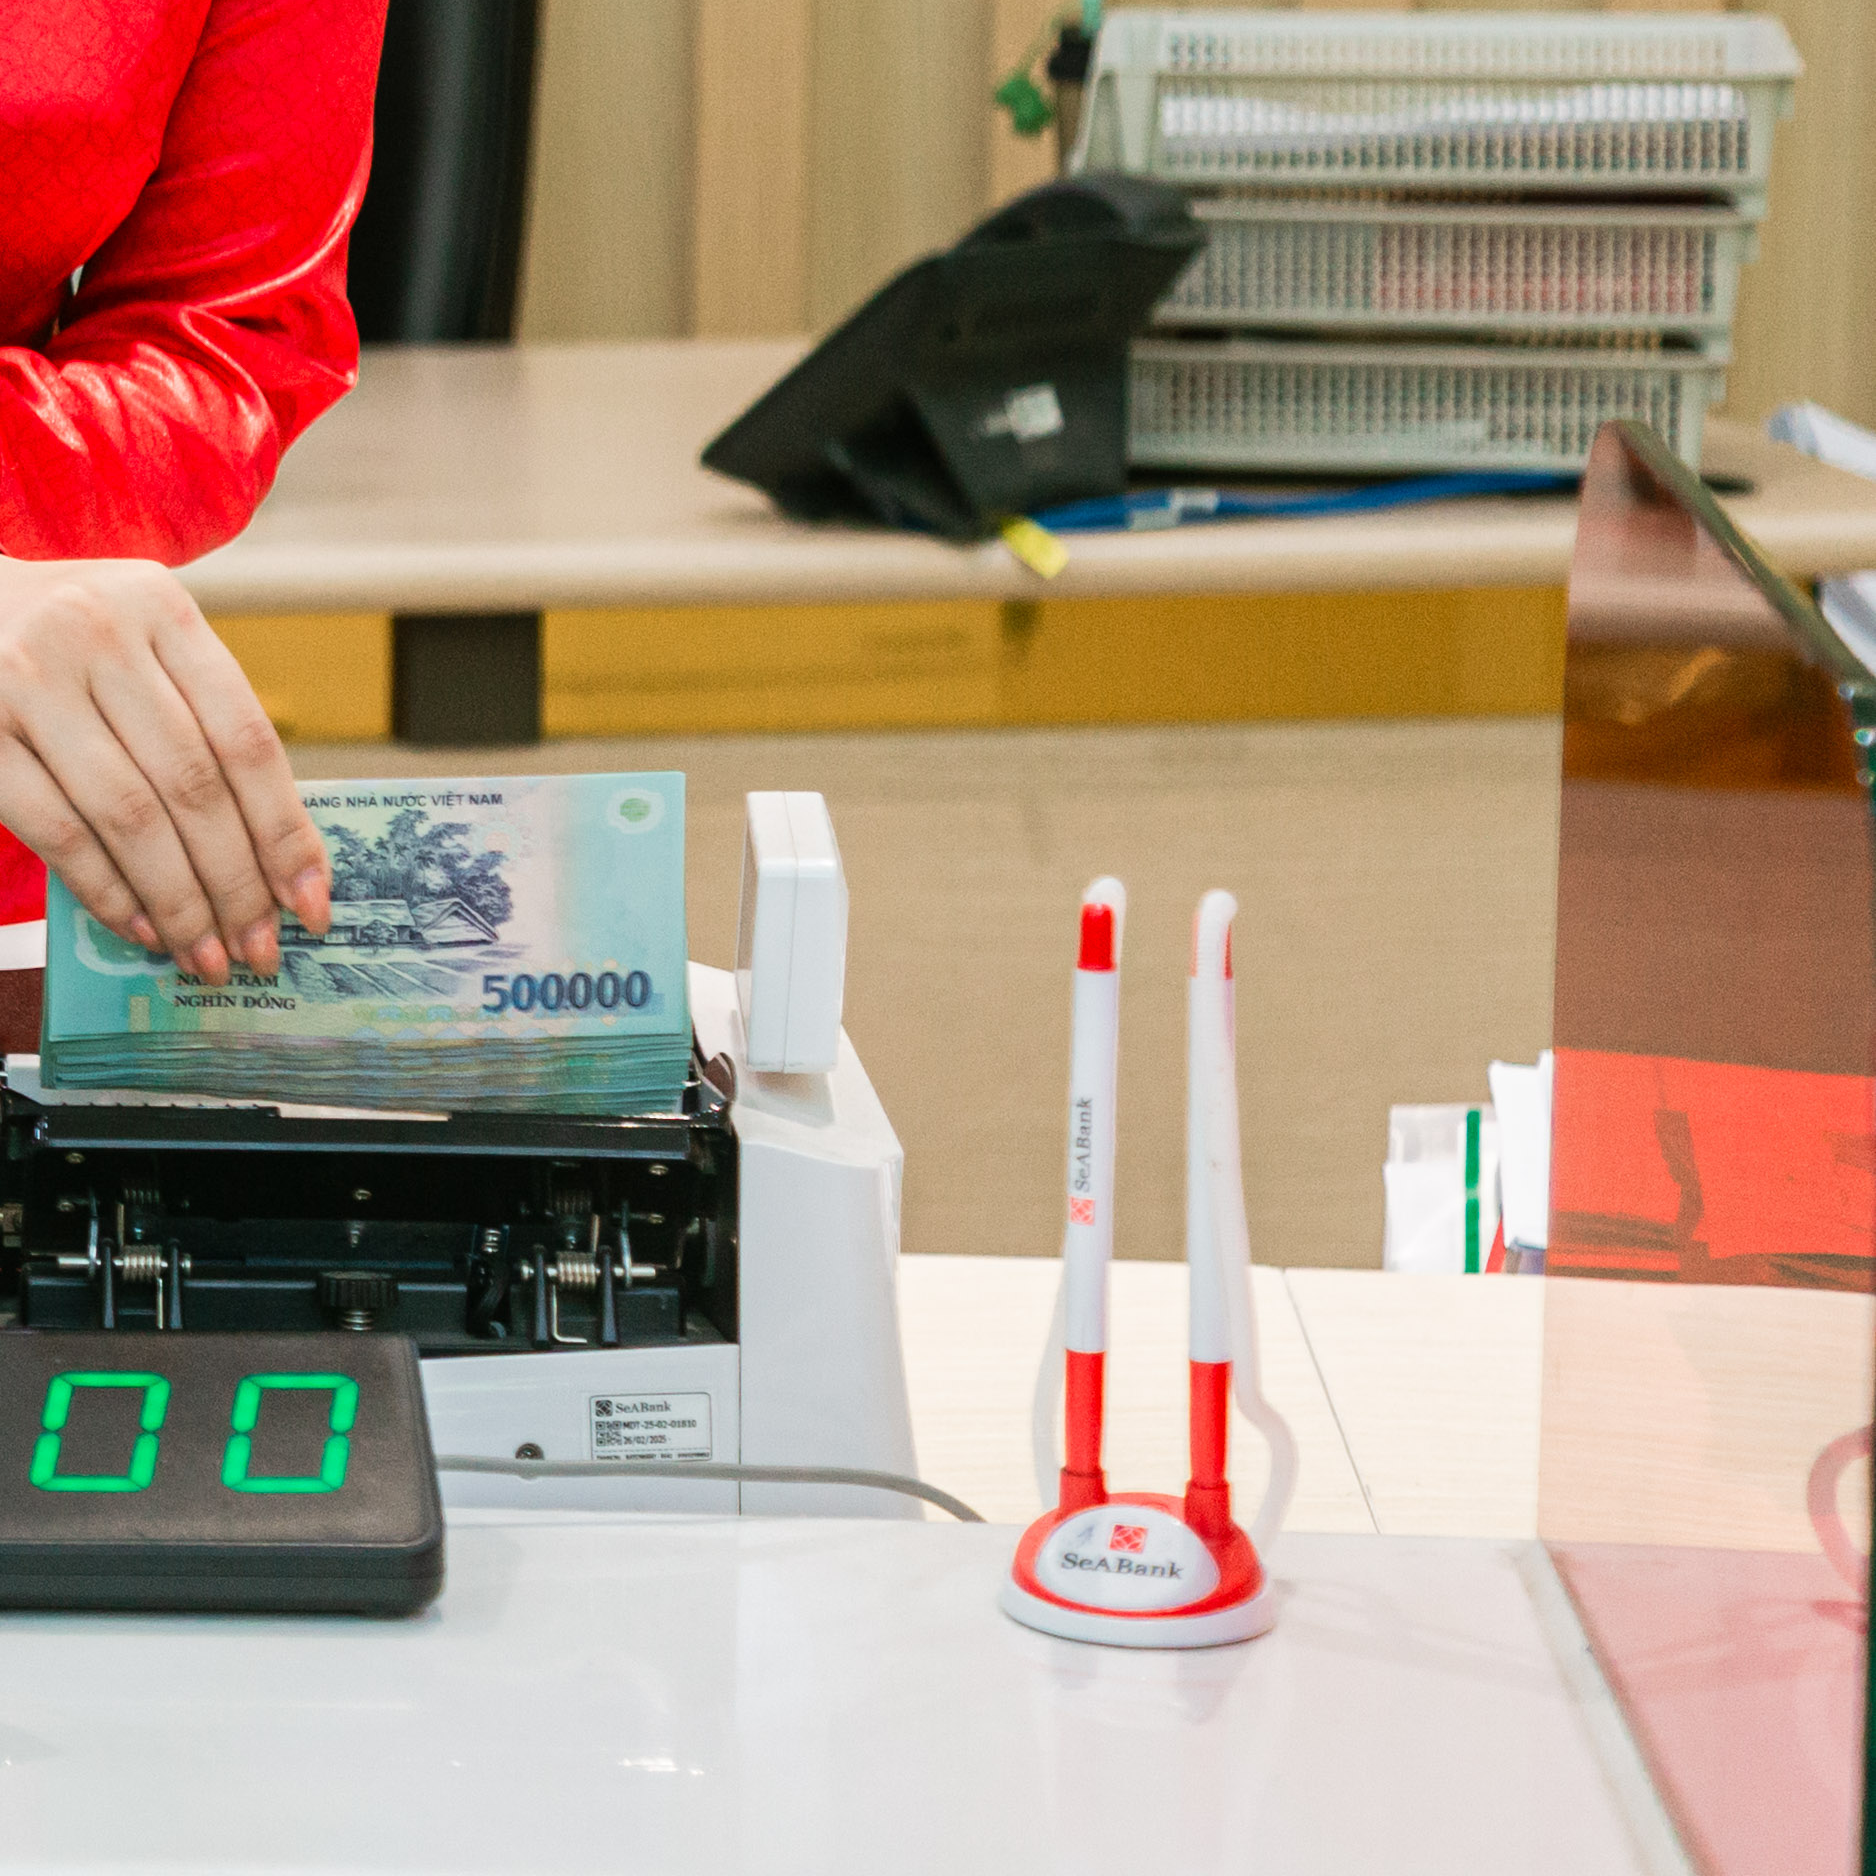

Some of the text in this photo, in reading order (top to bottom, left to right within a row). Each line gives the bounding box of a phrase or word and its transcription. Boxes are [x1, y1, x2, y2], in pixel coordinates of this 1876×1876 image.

[347, 792, 378, 808] NHÀ
[383, 792, 426, 808] NƯỚC
[431, 790, 464, 810] VIỆT
[469, 793, 503, 805] NAM
[174, 991, 296, 1010] NGHÌN ĐỒNG
[482, 970, 653, 1014] 500000
[1075, 1097, 1094, 1193] SeABank
[615, 1400, 672, 1414] SeABank
[1060, 1551, 1184, 1582] SeABank
